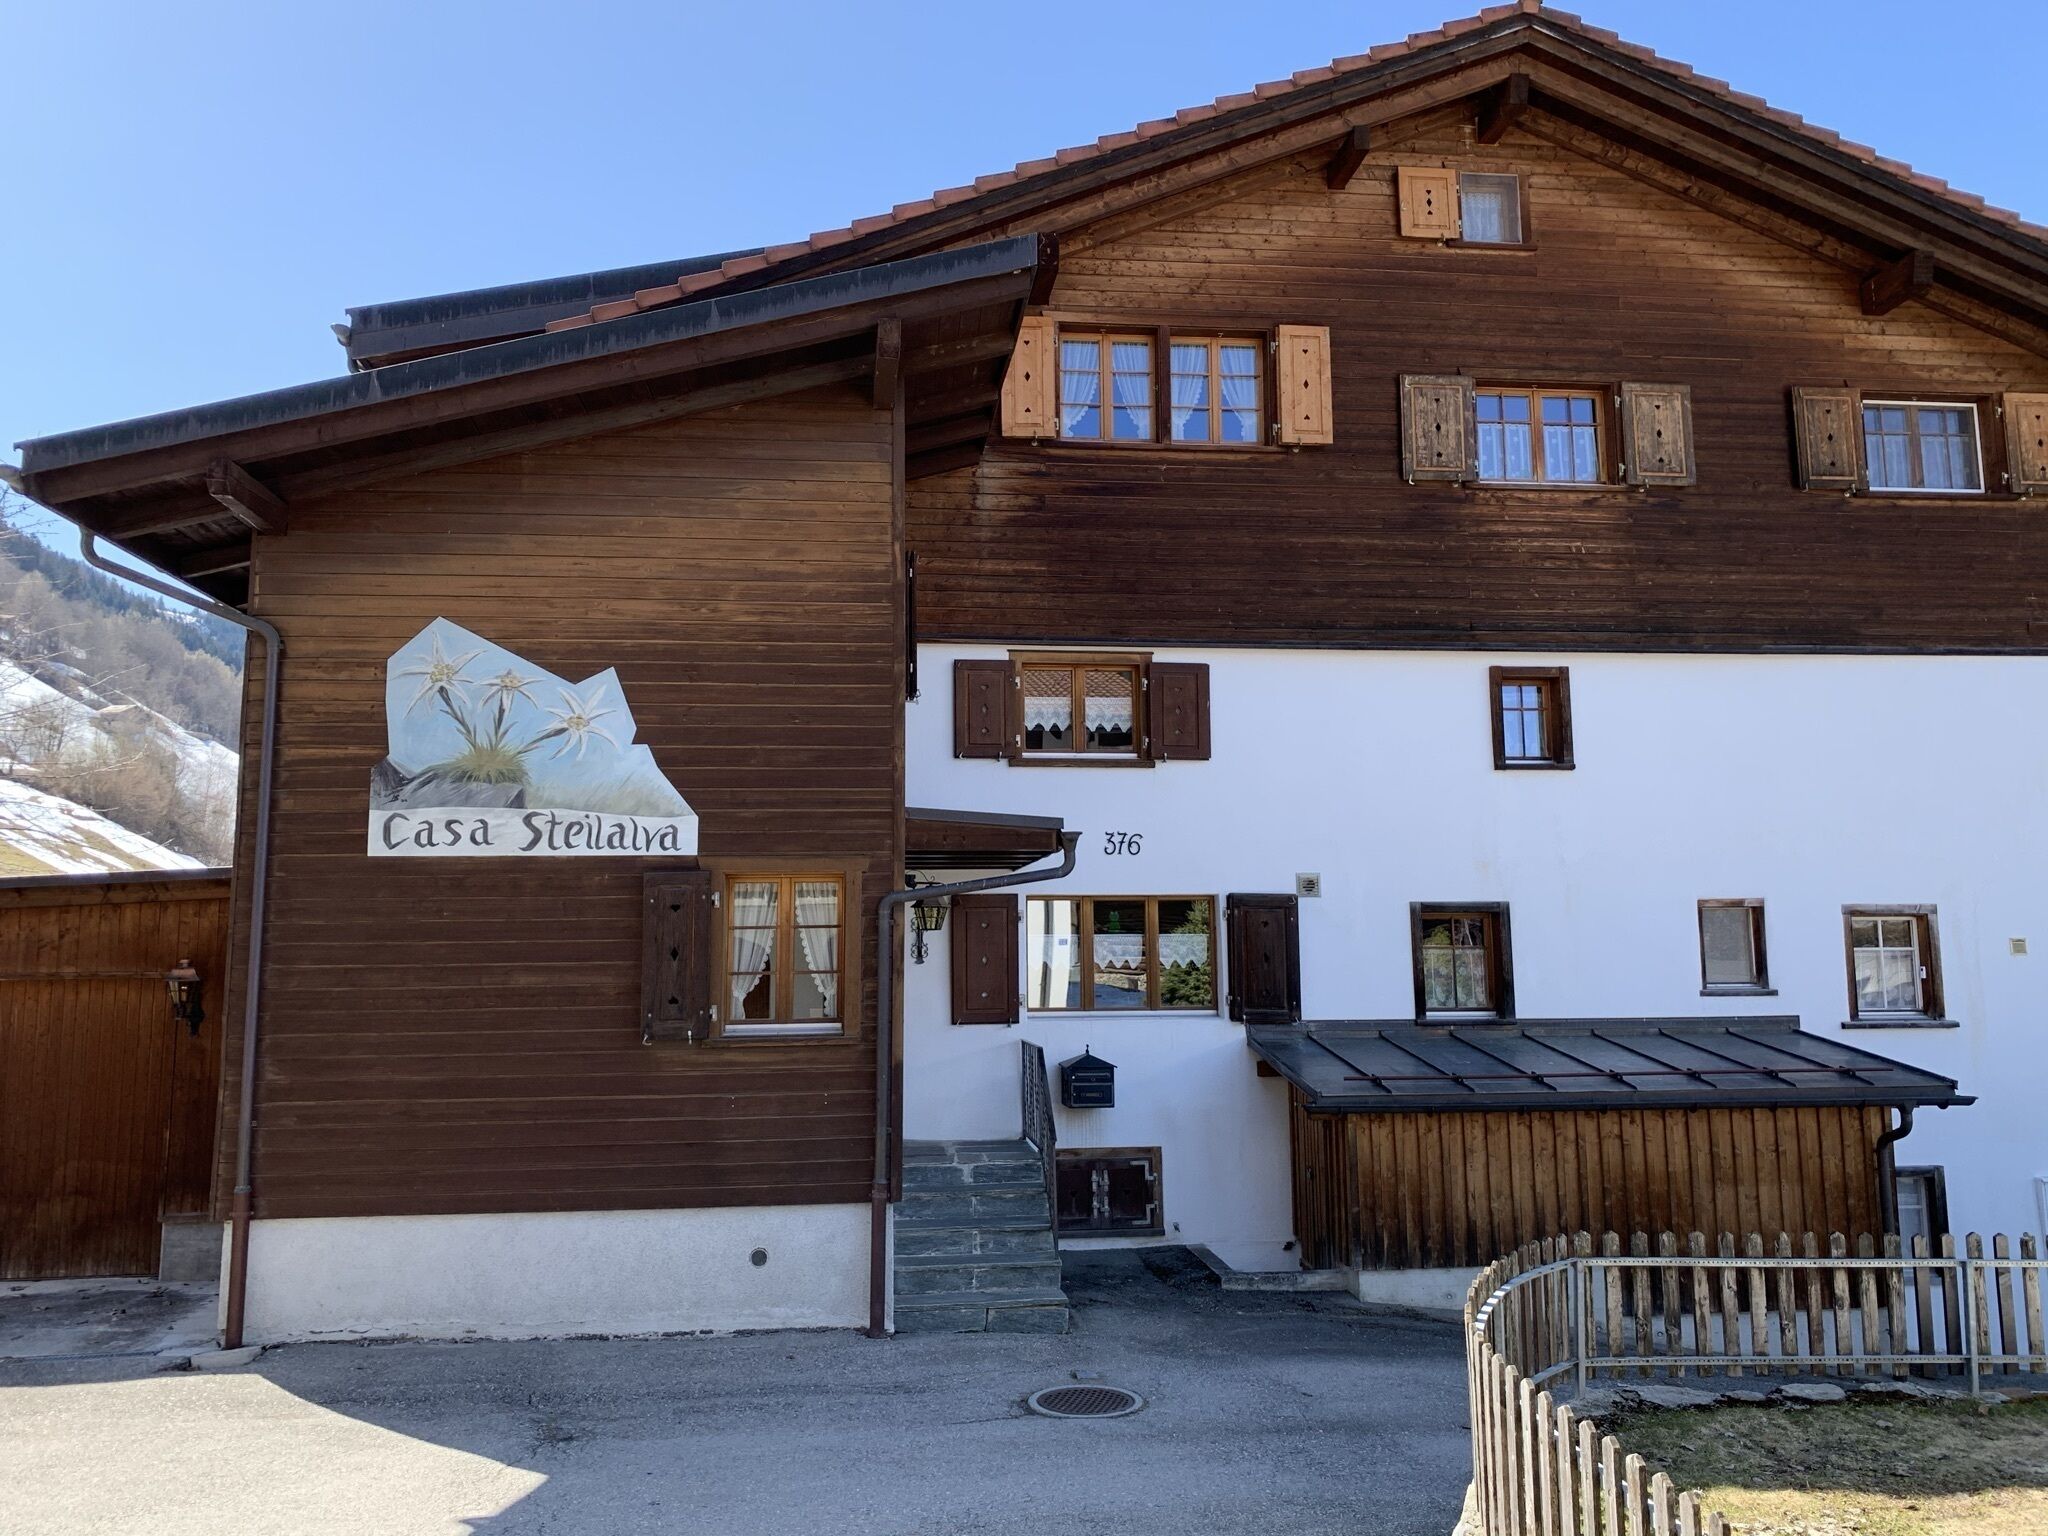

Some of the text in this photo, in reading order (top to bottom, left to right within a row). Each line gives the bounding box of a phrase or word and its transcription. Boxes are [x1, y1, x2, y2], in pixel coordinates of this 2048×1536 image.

[382, 809, 682, 852] Casa Steilalva
[1104, 831, 1143, 855] 376
